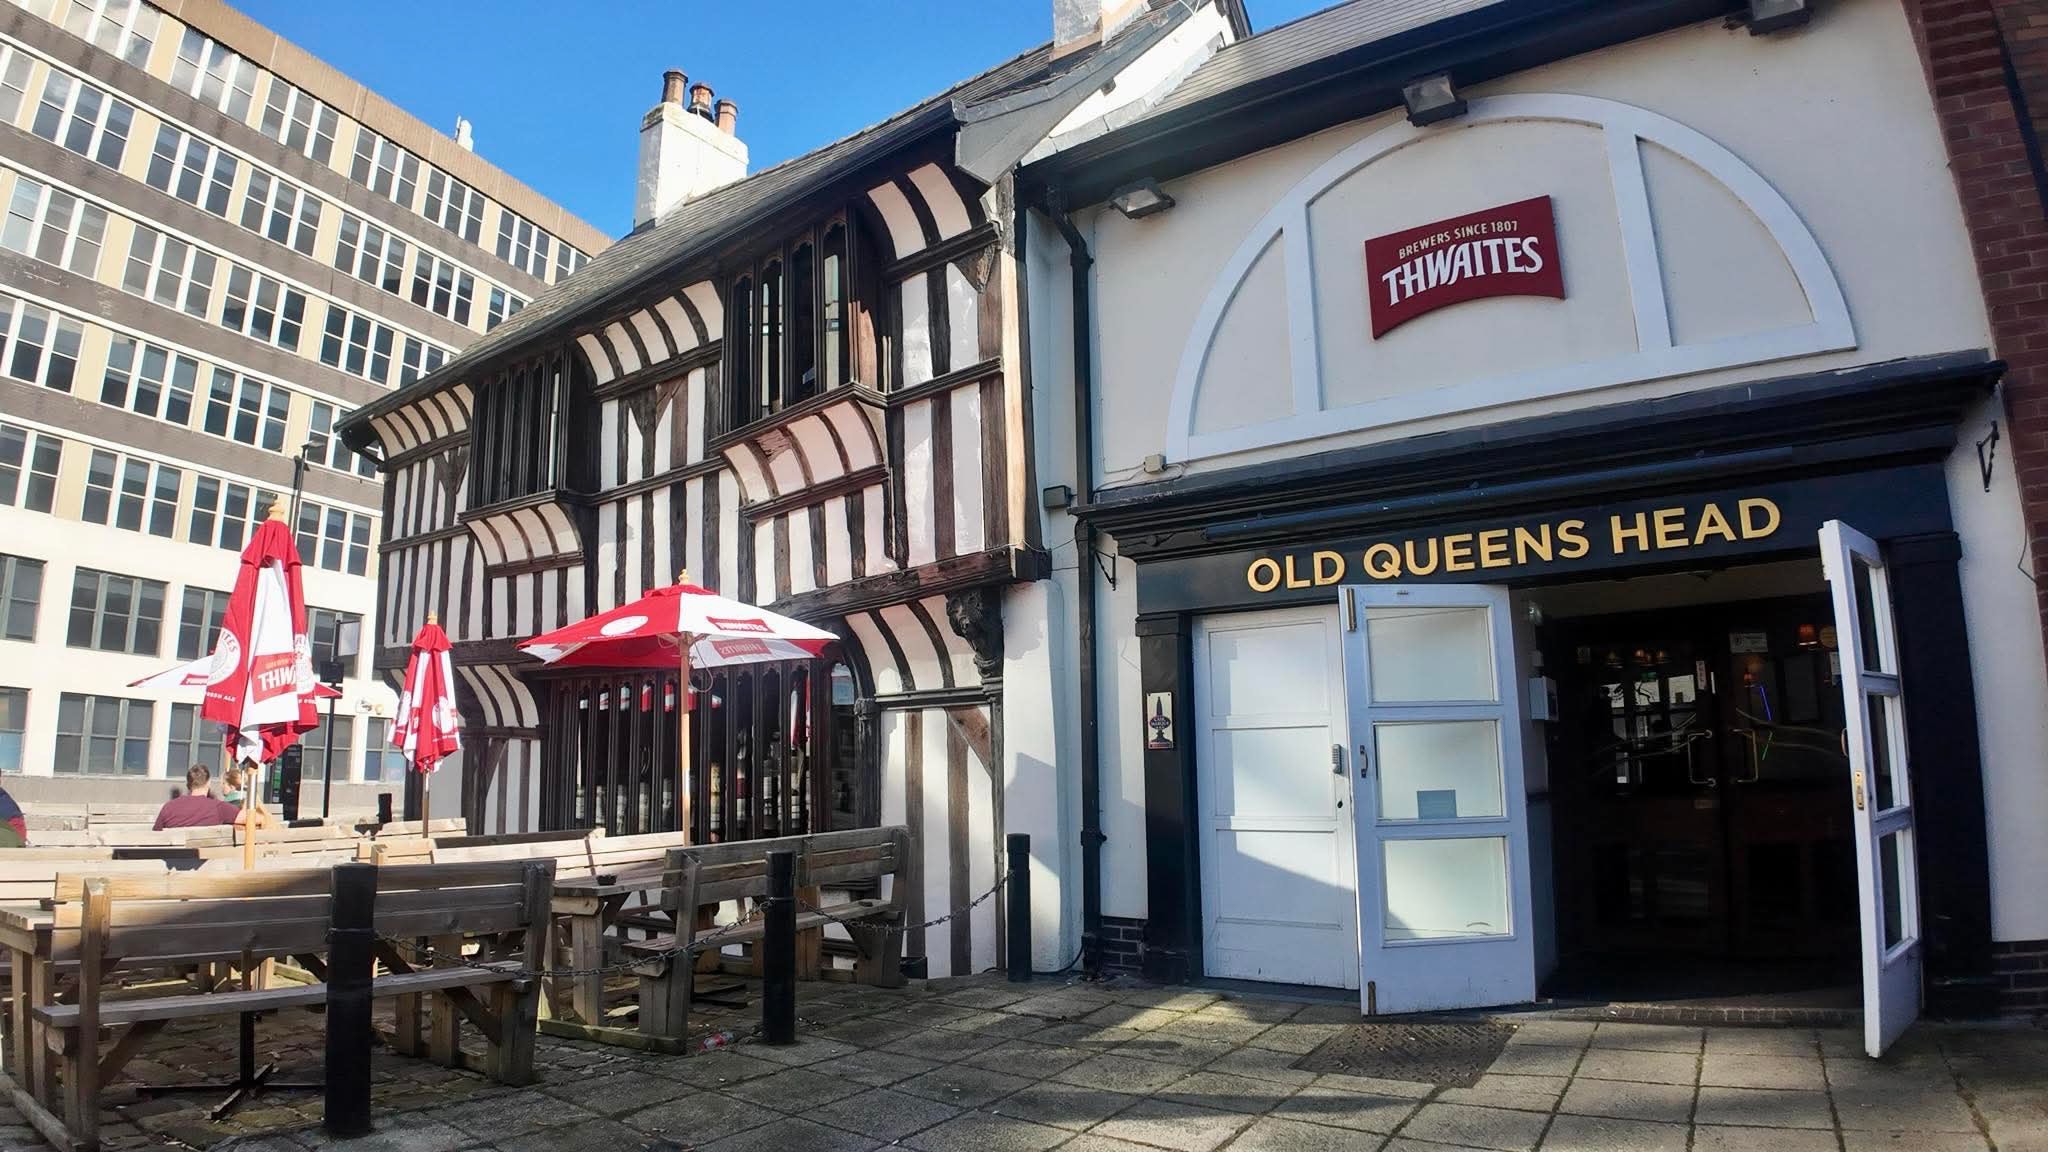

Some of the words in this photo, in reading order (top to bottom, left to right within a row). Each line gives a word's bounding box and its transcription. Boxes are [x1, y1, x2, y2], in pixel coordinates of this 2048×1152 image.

[1381, 236, 1544, 307] THWAITES
[1398, 231, 1451, 260] BREWERS
[1454, 222, 1488, 240] SINCE
[1491, 220, 1518, 234] 1807
[1247, 549, 1346, 593] OLD
[1363, 519, 1590, 579] QUEENS
[1610, 497, 1782, 555] HEAD
